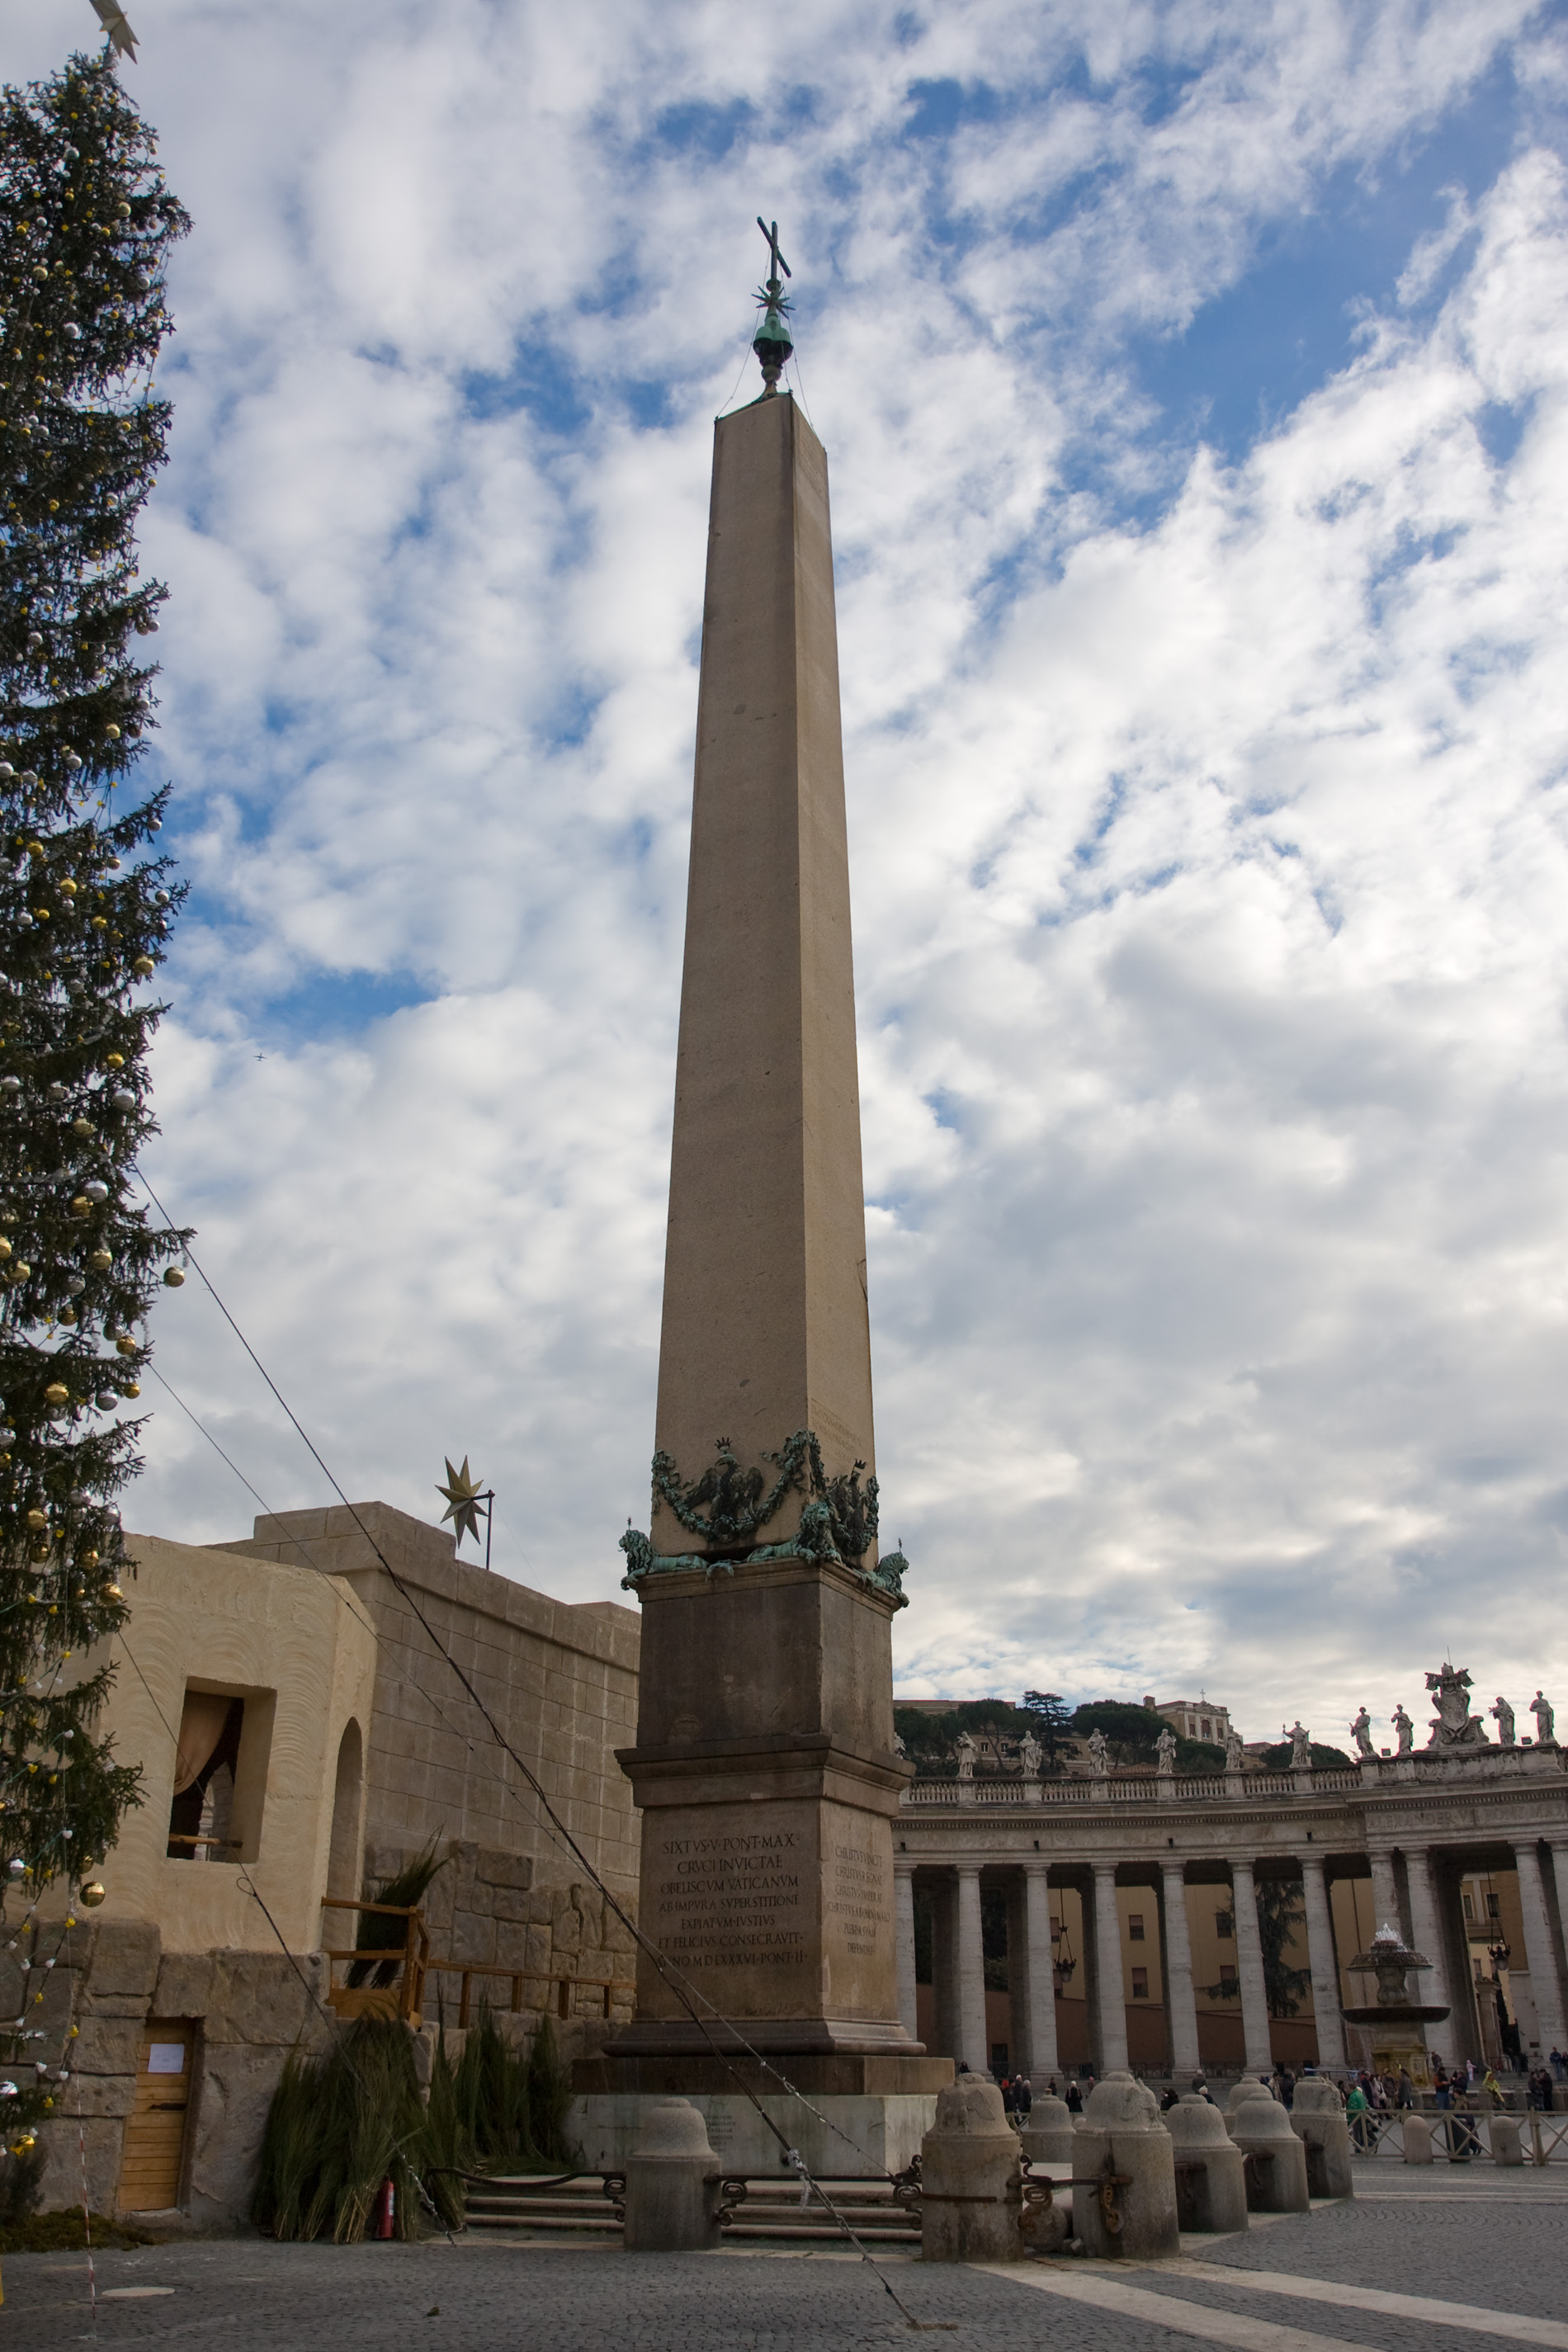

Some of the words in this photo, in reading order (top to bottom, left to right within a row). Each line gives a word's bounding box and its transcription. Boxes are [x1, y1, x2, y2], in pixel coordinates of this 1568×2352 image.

[678, 1859, 716, 1874] CRVCI
[719, 1854, 783, 1872] INVICTAE
[660, 1880, 725, 1895] OBELISCVM
[727, 1875, 799, 1891] VATICANVM
[659, 1901, 673, 1913] AB
[675, 1899, 716, 1911] IMPVRA
[720, 1894, 799, 1909] SVPERSTITIONE
[736, 1915, 776, 1927] IVSTIVS
[659, 1937, 669, 1948] ET
[673, 1935, 716, 1948] FELICIVS
